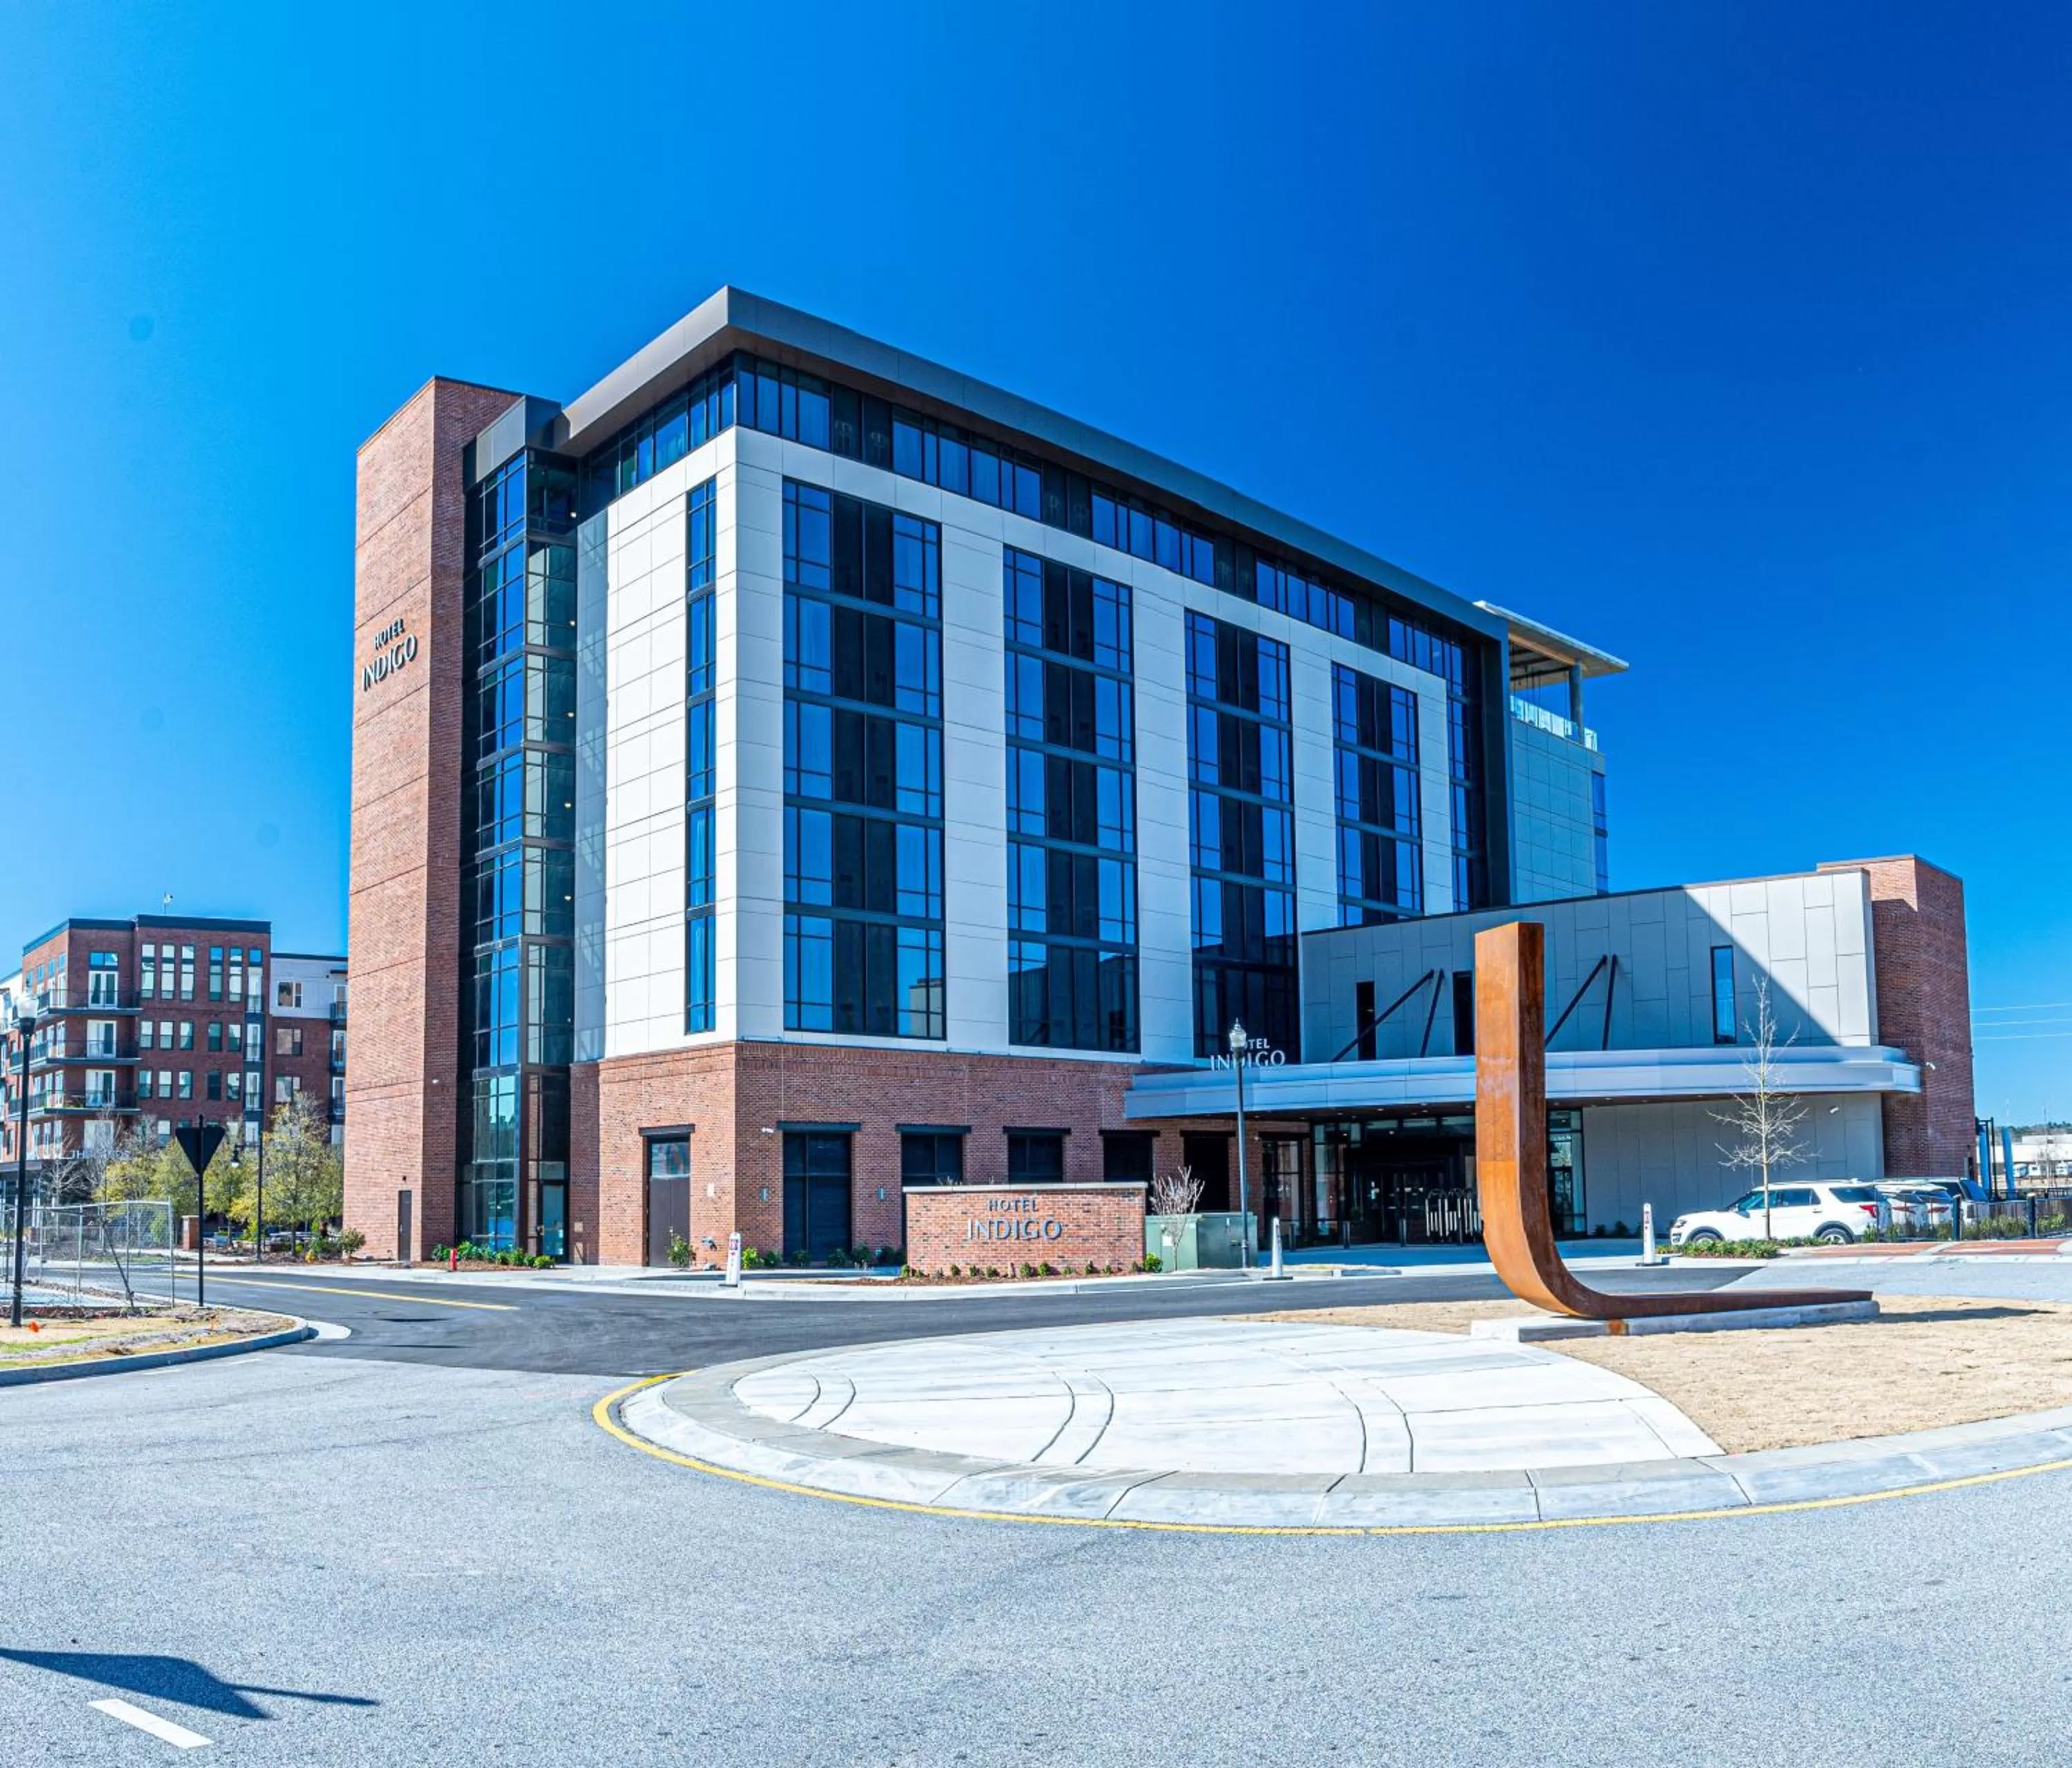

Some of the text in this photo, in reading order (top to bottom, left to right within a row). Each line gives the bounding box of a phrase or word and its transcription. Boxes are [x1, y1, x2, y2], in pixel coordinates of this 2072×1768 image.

[374, 618, 405, 651] HOTEL
[362, 634, 418, 692] INDIGO
[1235, 1038, 1270, 1049] TEL
[988, 1197, 1039, 1212] HOTEL
[968, 1216, 1062, 1240] INDIGO
